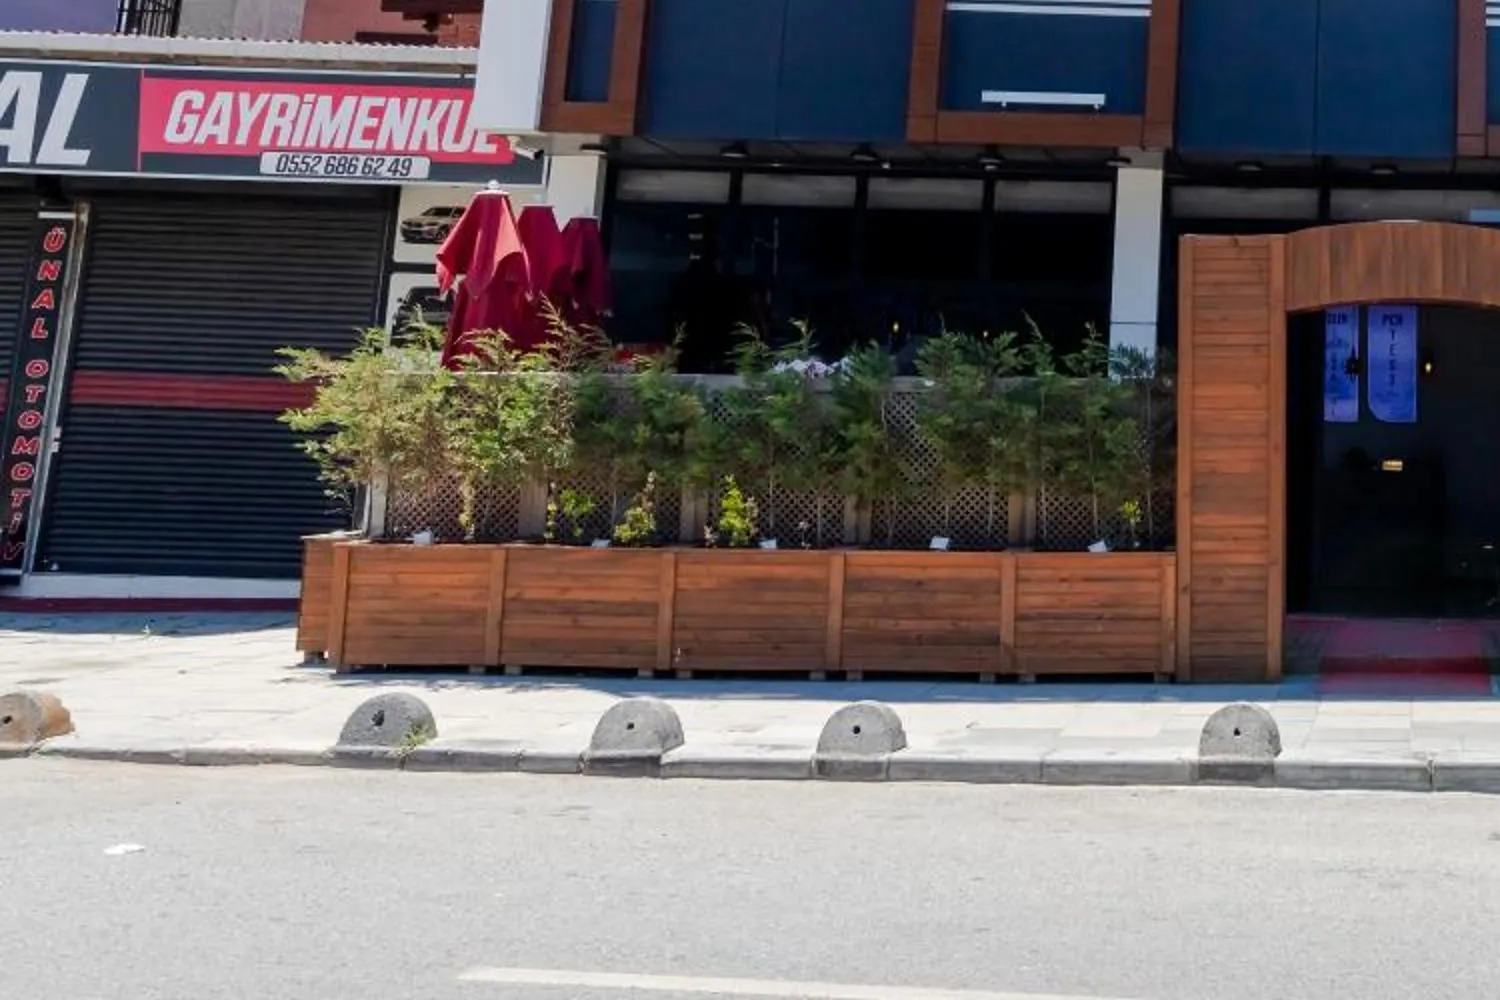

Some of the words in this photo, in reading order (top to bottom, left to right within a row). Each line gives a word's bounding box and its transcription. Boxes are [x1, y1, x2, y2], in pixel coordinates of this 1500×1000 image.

[276, 154, 322, 174] 0552
[323, 156, 359, 175] 686
[361, 157, 385, 176] 62
[387, 158, 413, 177] 49
[31, 226, 67, 339] ÜNAL
